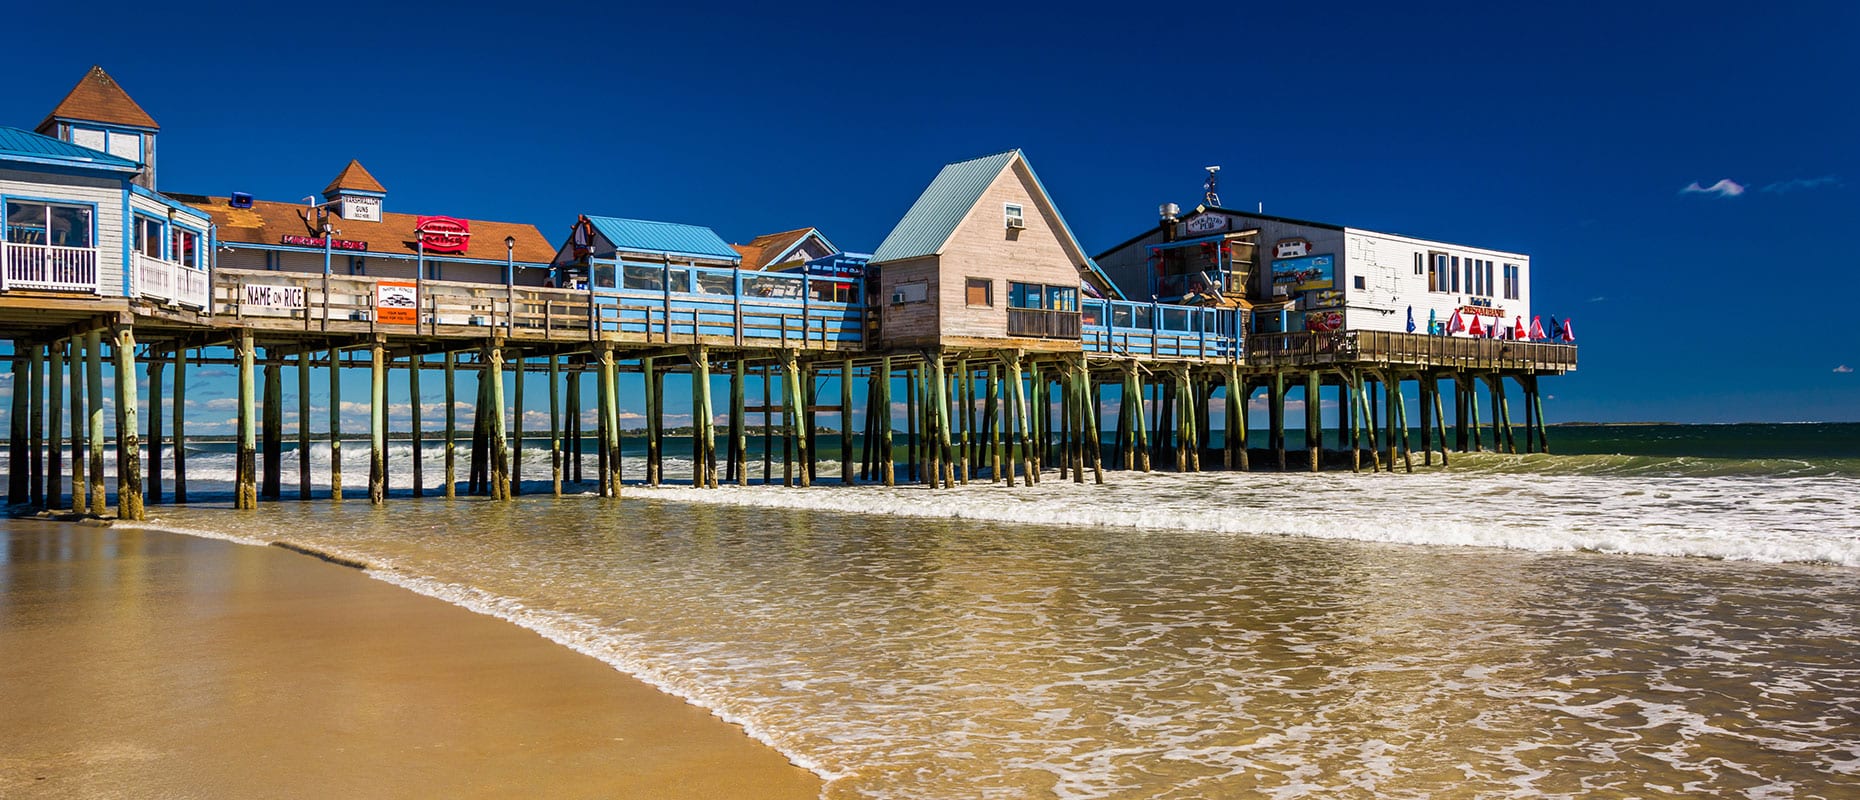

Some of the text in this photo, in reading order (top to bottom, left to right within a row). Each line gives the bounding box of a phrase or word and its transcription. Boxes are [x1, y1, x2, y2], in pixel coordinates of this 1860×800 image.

[355, 205, 369, 213] GUNS
[342, 240, 366, 250] GUNS
[248, 286, 302, 307] NAME ON RICE
[1464, 306, 1504, 318] RESTAURANT
